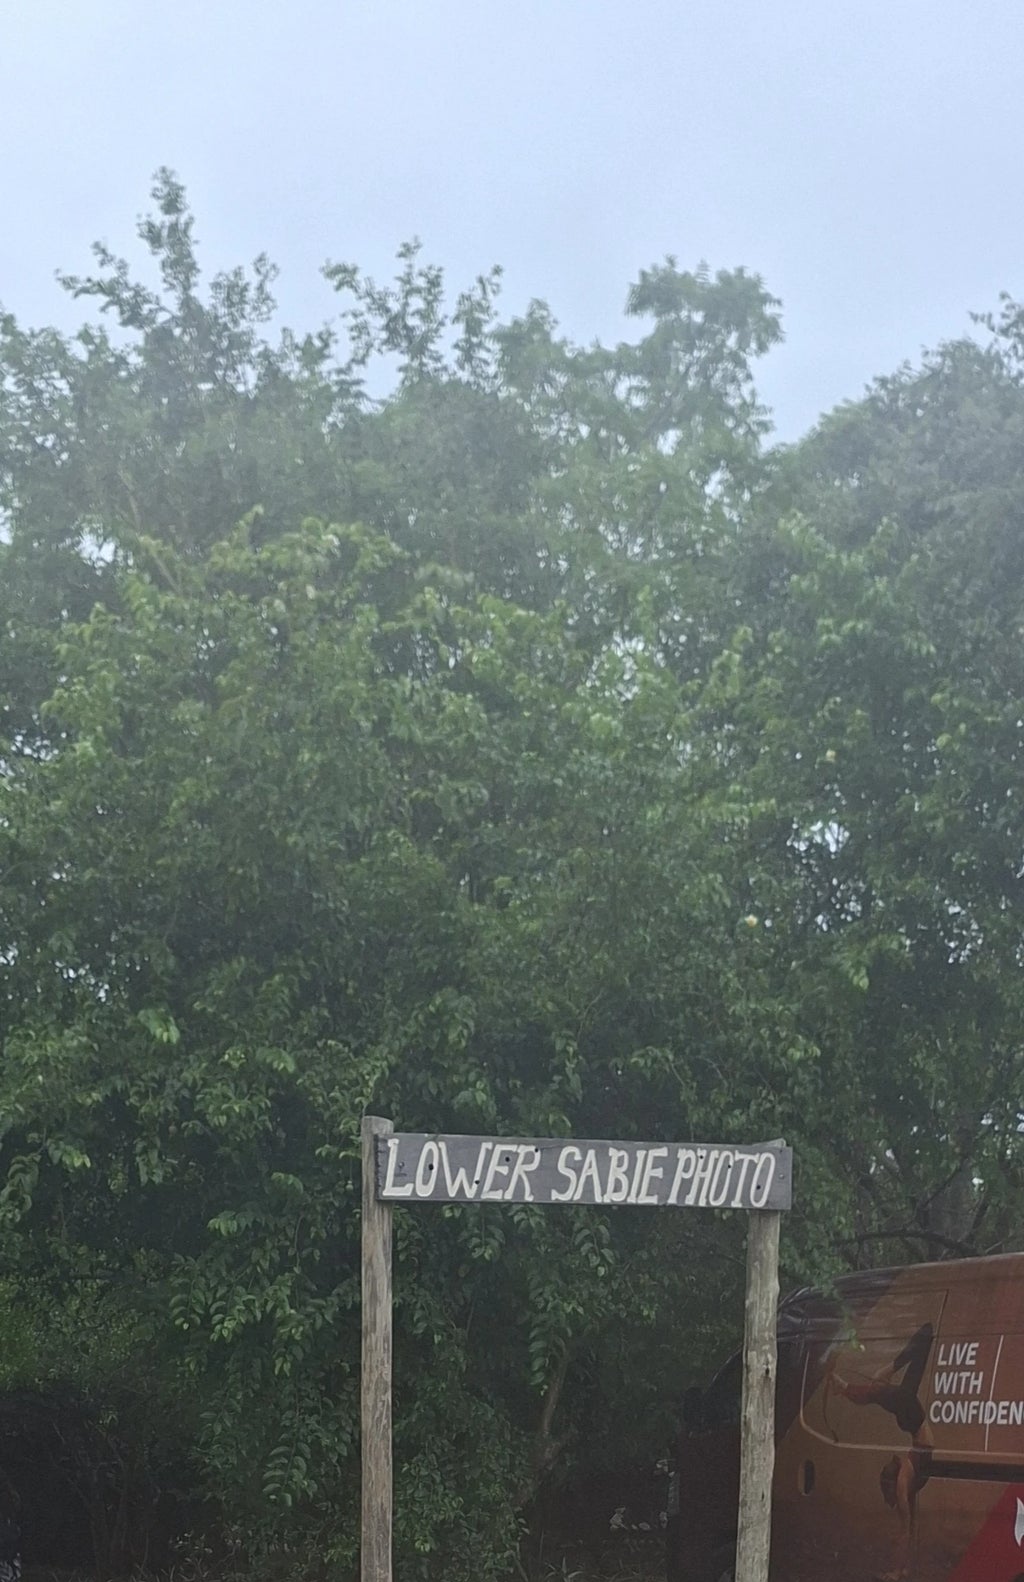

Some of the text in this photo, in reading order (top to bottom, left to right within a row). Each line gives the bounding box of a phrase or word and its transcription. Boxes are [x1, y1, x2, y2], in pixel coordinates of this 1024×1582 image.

[382, 1138, 776, 1208] LOWER SABIE PHOTO
[937, 1342, 980, 1366] LIVE
[934, 1371, 984, 1395] WITH
[929, 1400, 1024, 1425] CONFIDEN
